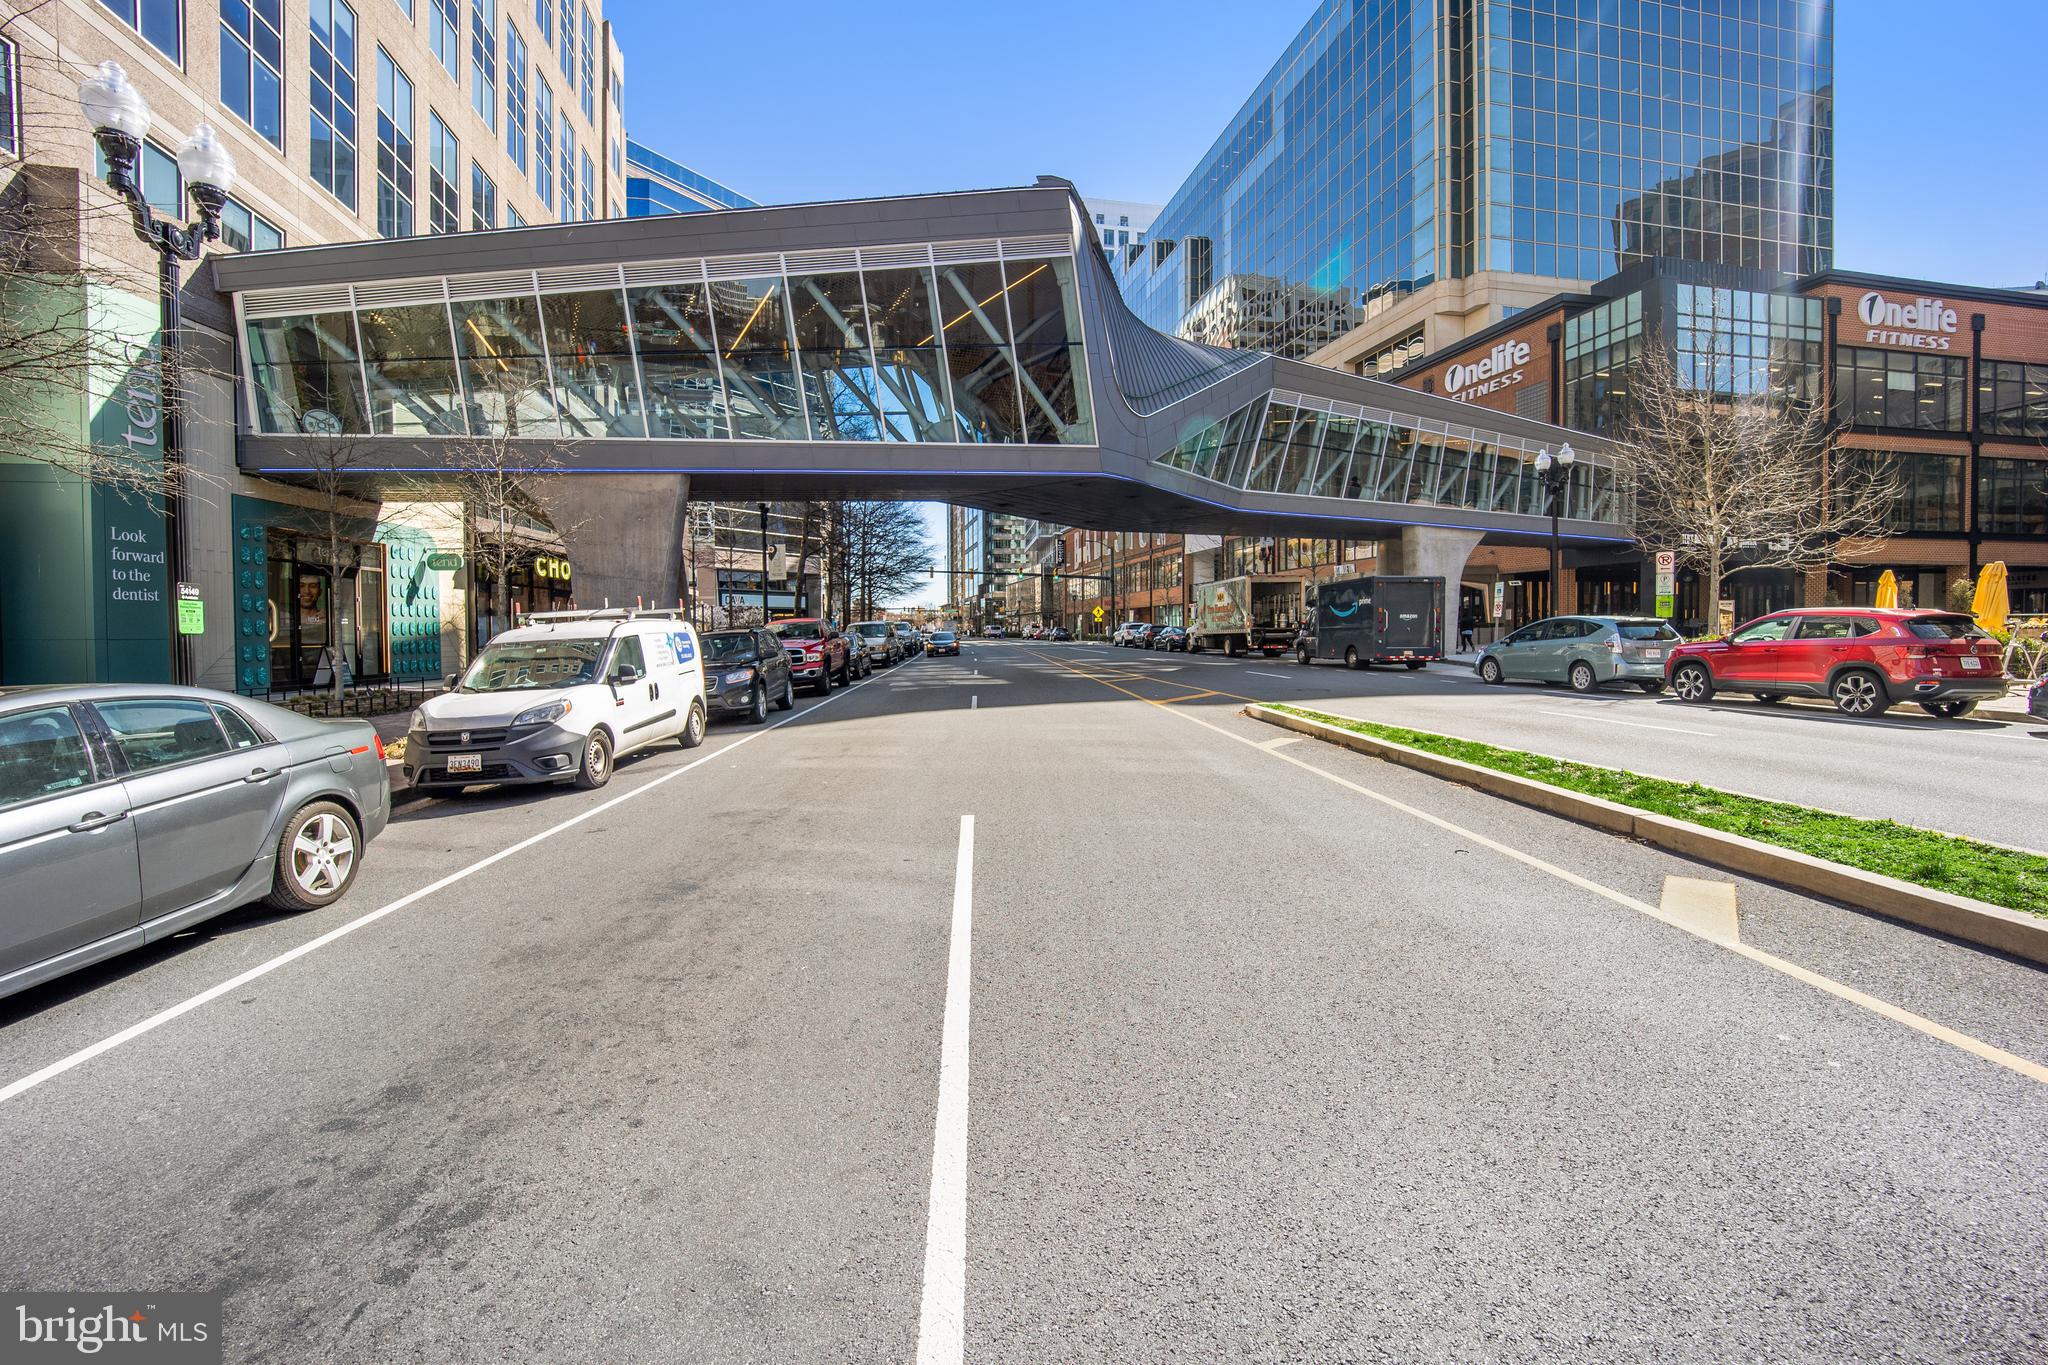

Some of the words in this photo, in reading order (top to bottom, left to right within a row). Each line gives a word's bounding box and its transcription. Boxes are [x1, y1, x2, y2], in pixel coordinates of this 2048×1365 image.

[1857, 291, 1958, 333] Onelife
[1865, 329, 1951, 350] FITNESS
[1444, 339, 1531, 393] Onelife
[111, 526, 148, 544] Look
[111, 546, 165, 564] forward
[112, 568, 126, 580] to
[128, 568, 151, 582] the
[112, 587, 160, 602] dentist
[1359, 596, 1372, 606] prime
